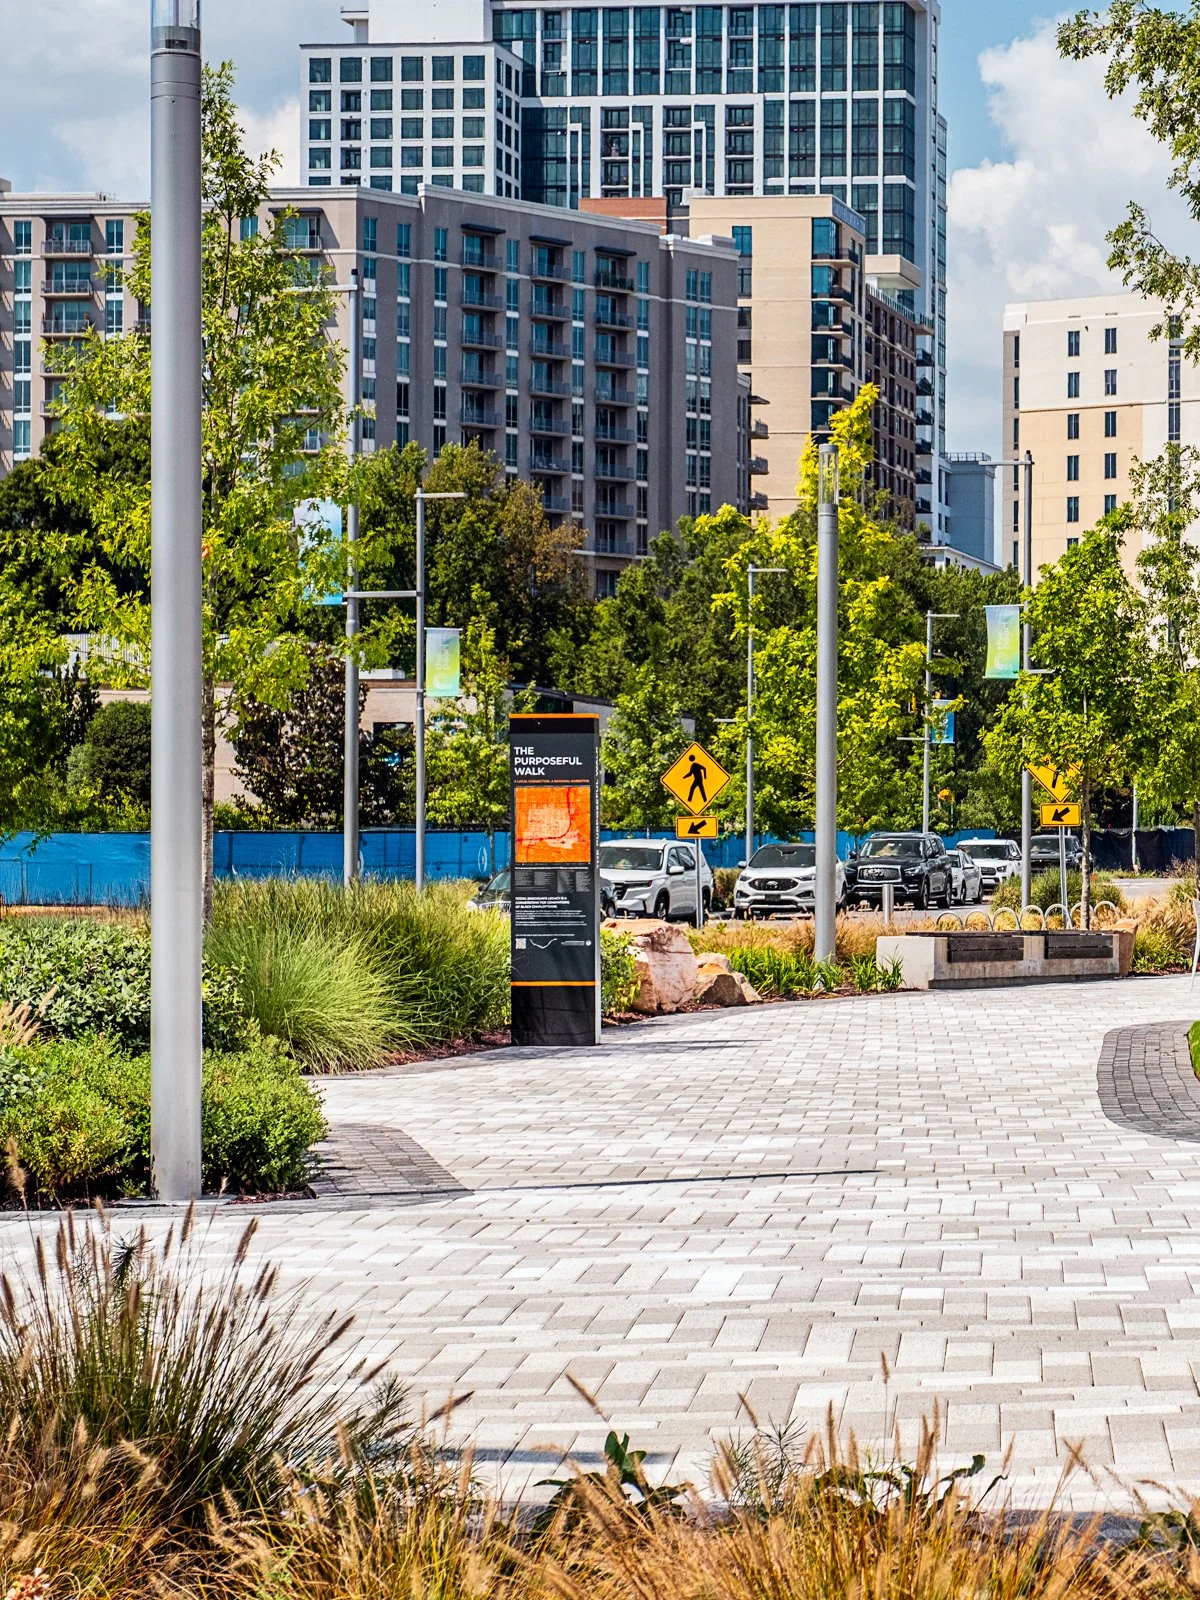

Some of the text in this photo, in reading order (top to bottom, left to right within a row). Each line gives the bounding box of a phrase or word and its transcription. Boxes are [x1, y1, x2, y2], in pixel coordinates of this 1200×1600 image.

[514, 747, 535, 755] THE
[514, 757, 583, 765] PURPOSEFUL
[514, 767, 545, 776] WALK
